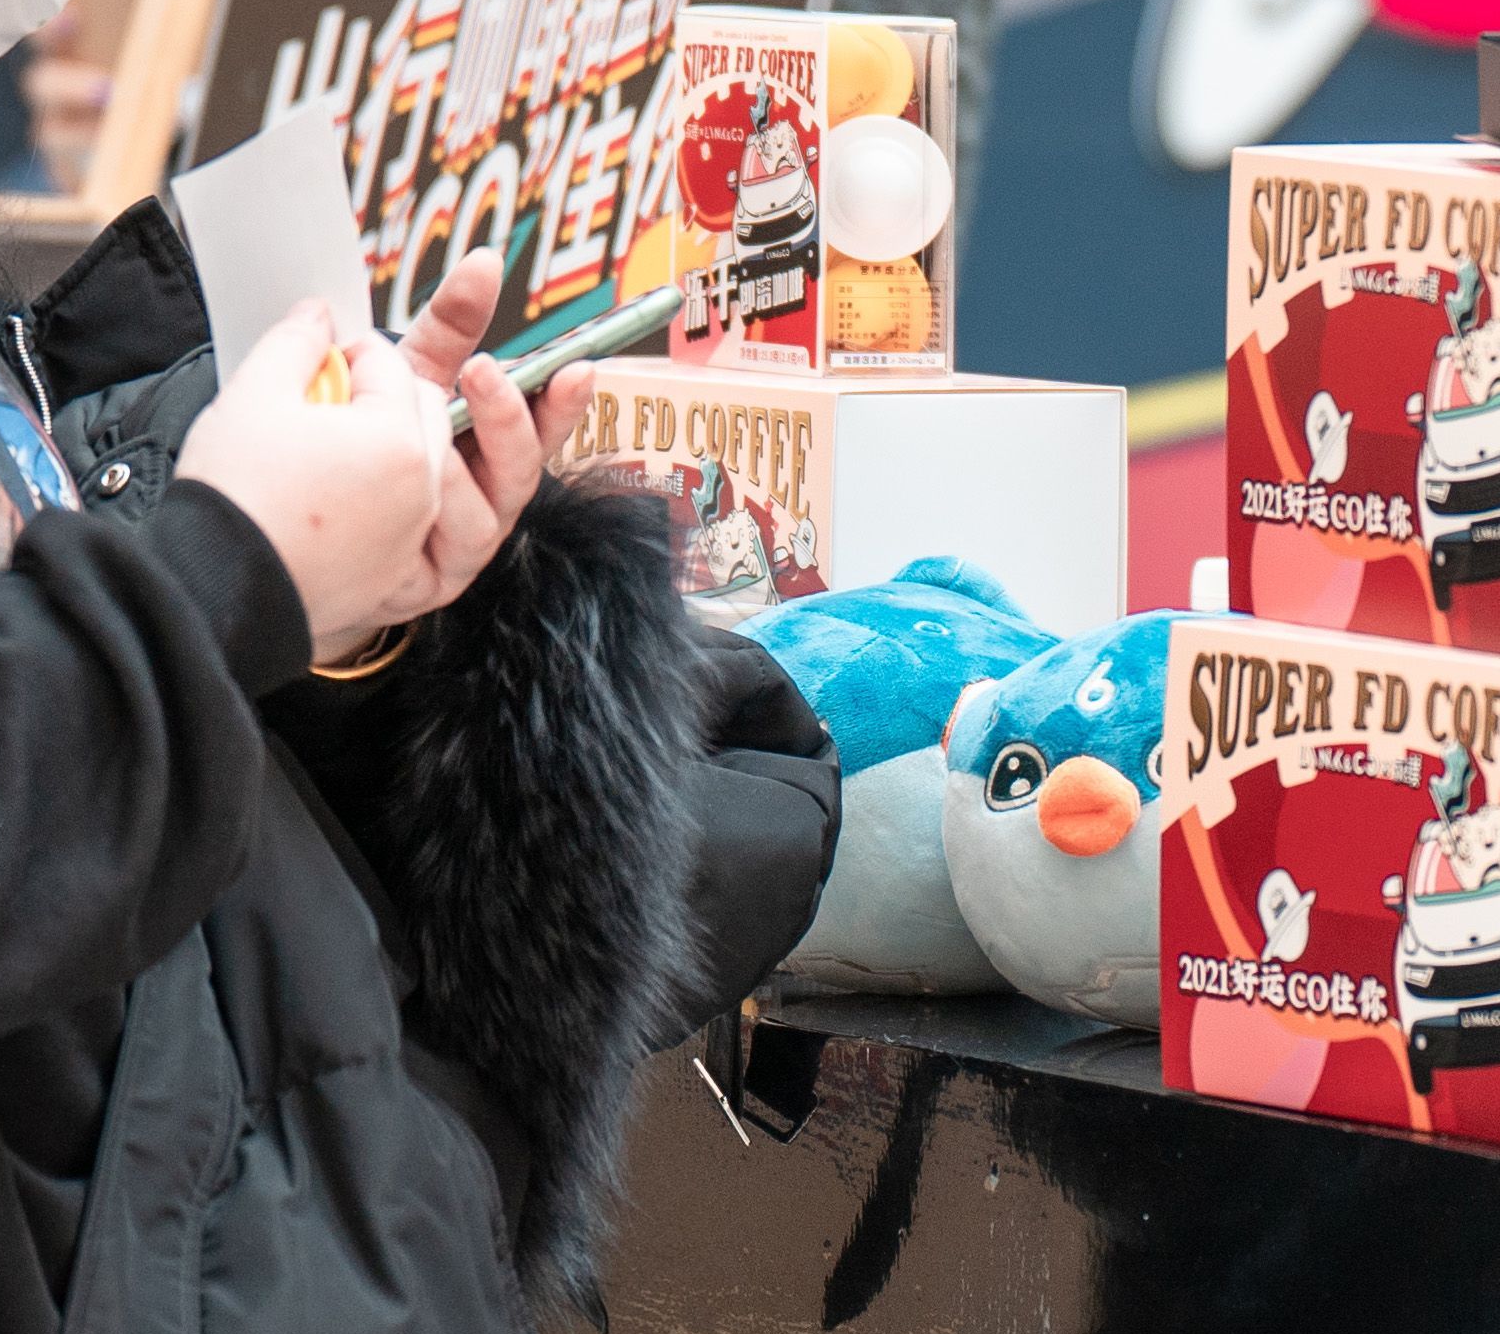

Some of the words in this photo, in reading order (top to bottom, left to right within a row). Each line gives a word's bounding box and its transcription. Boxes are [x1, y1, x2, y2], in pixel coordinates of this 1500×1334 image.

[683, 44, 729, 97] SUPER
[735, 47, 754, 72] FD
[759, 49, 817, 109] COFFEE
[1248, 177, 1369, 307] SUPER
[1385, 190, 1433, 252] FD
[573, 391, 620, 460] ER
[634, 395, 677, 452] FD
[685, 400, 813, 525] COFFEE
[1240, 479, 1416, 542] 2021好运CO住你
[1186, 652, 1336, 782] SUPER
[1353, 670, 1411, 735] FD
[1178, 954, 1389, 1023] 2021好运CO住你
